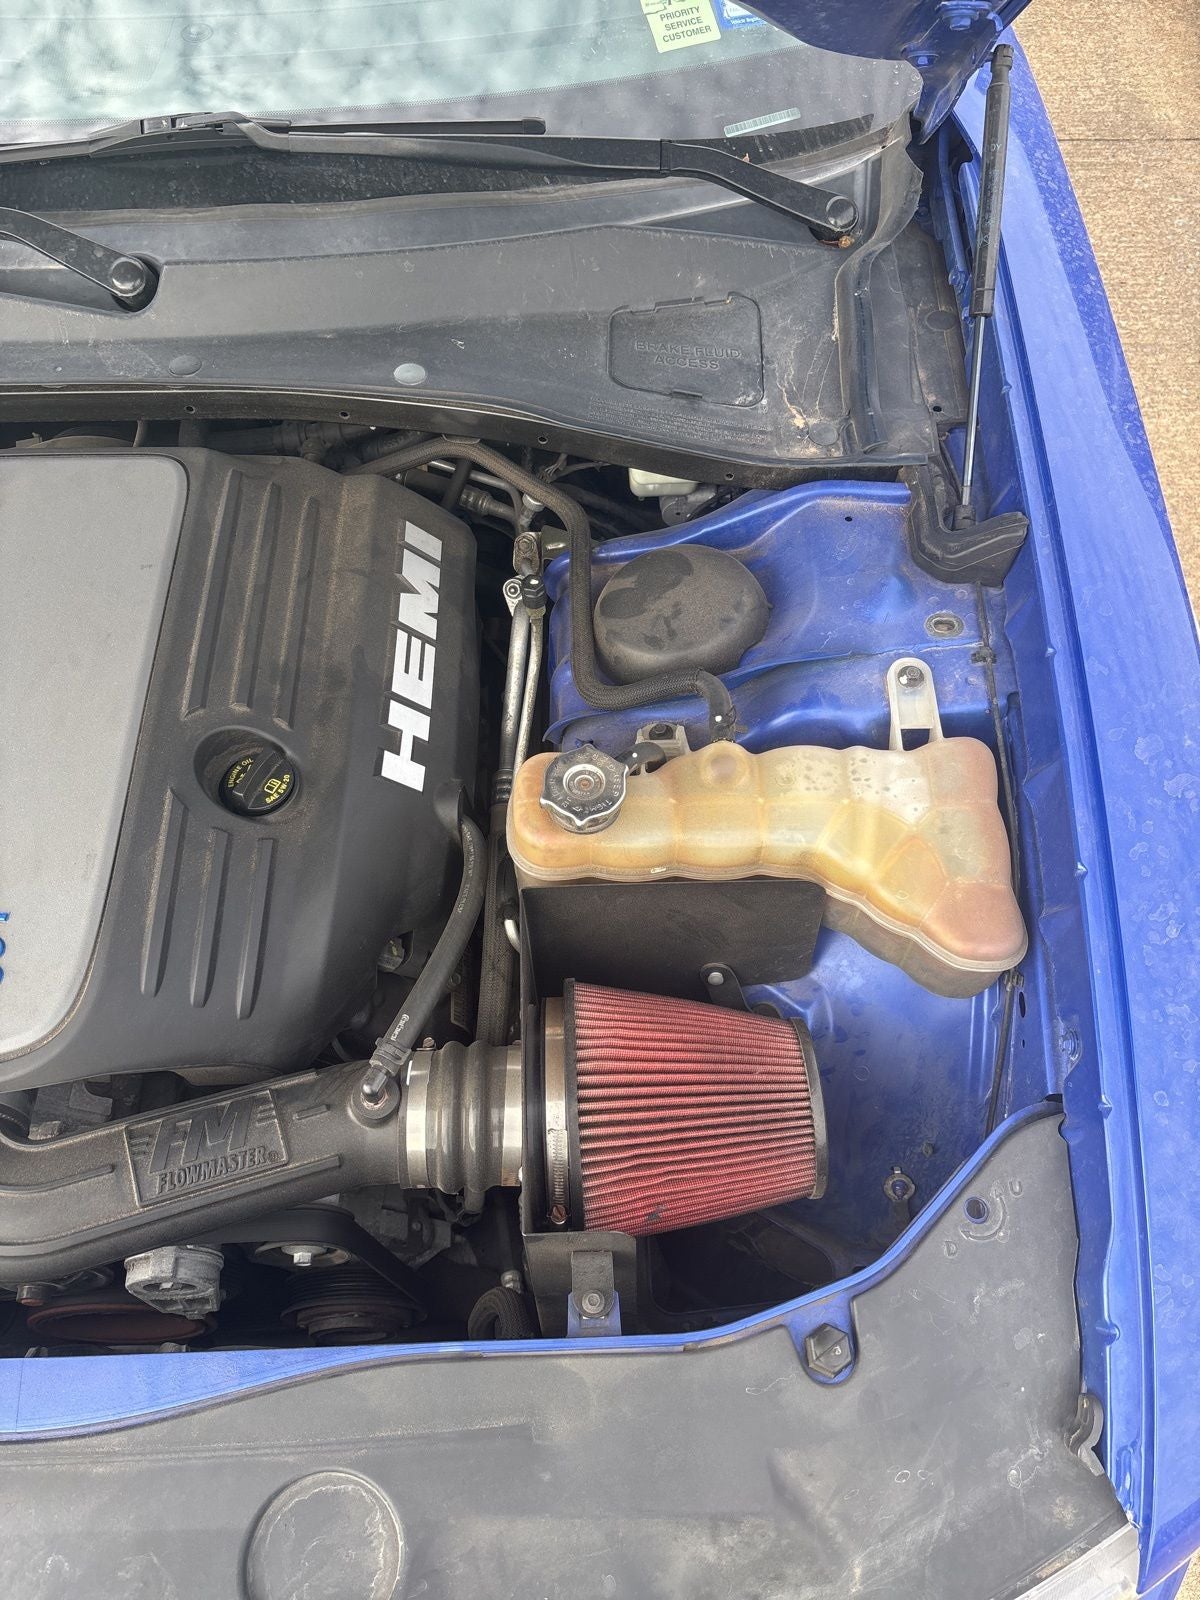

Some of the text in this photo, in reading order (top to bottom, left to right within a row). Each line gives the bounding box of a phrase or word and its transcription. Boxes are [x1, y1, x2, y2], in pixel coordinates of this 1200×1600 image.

[660, 6, 701, 21] PRIORITY
[664, 16, 704, 31] SERVICE
[662, 25, 712, 43] CUSTOMER
[635, 341, 743, 359] BRAKE FLUID
[654, 354, 720, 370] ACCESS
[380, 520, 443, 792] HEMI
[227, 757, 254, 788] ENGINE OIL
[265, 774, 291, 804] SAE 5W-20
[156, 1145, 268, 1195] FLOWMASTER
